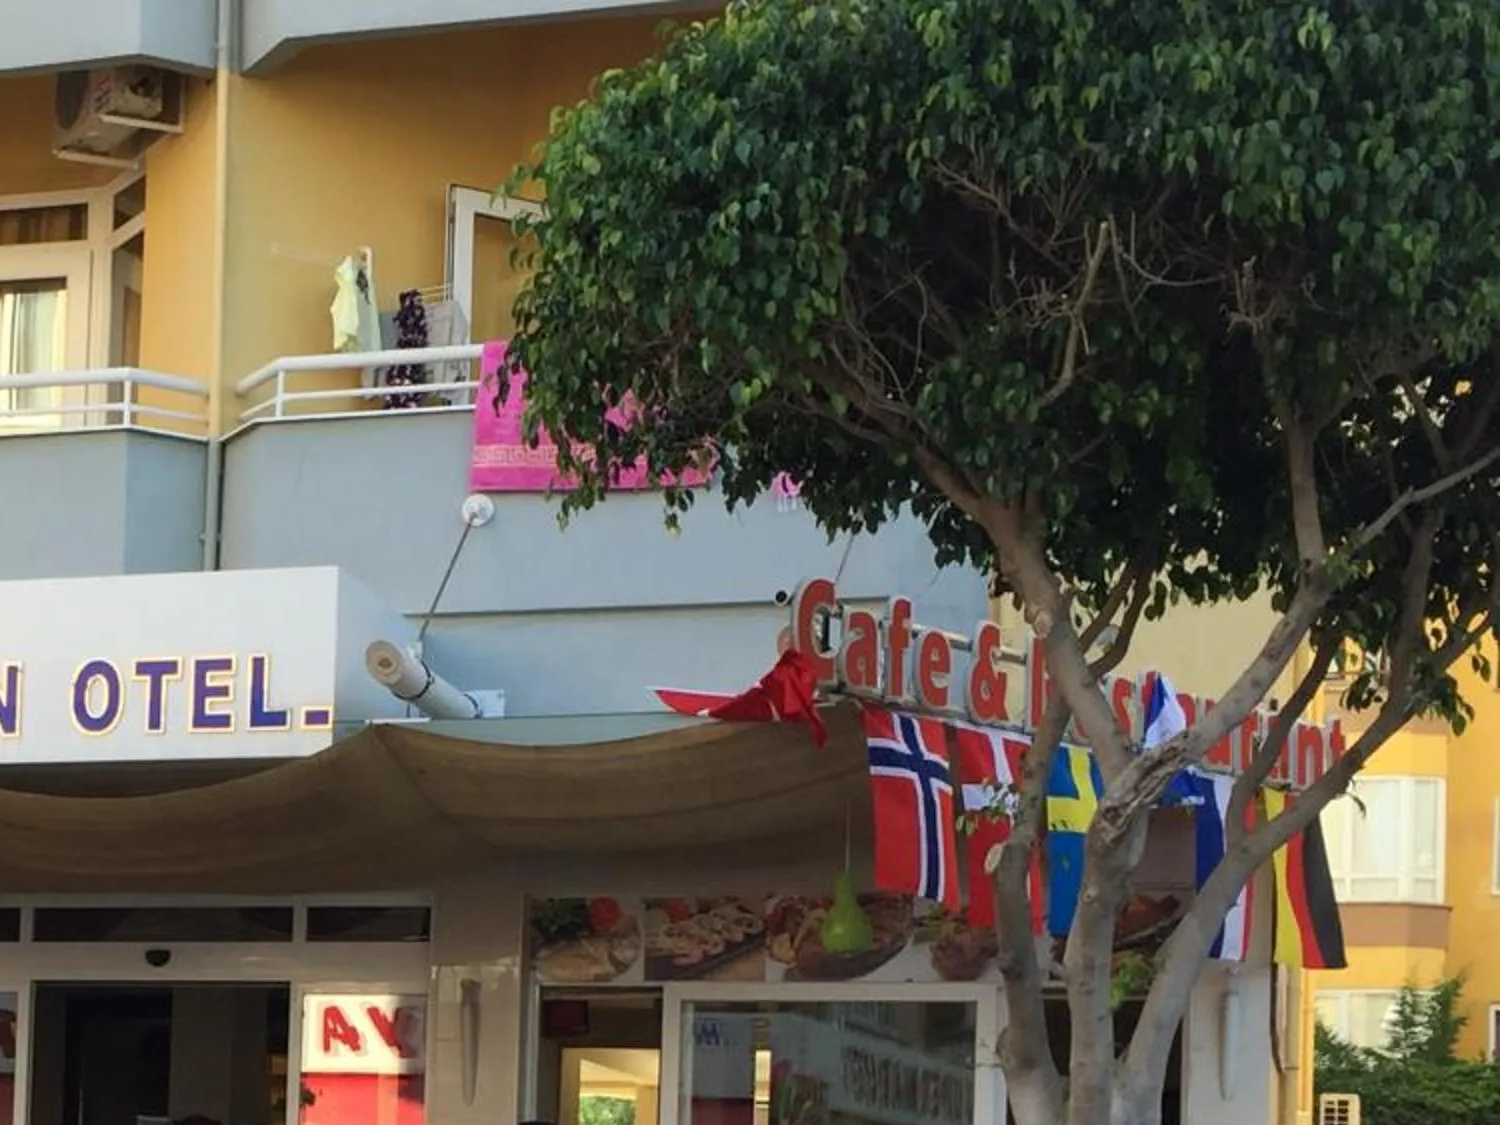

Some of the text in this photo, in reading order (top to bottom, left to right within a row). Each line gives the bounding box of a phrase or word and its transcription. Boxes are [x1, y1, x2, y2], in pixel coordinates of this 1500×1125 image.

[71, 654, 291, 734] OTEL
[797, 577, 953, 708] Cafe
[970, 621, 1009, 723] &
